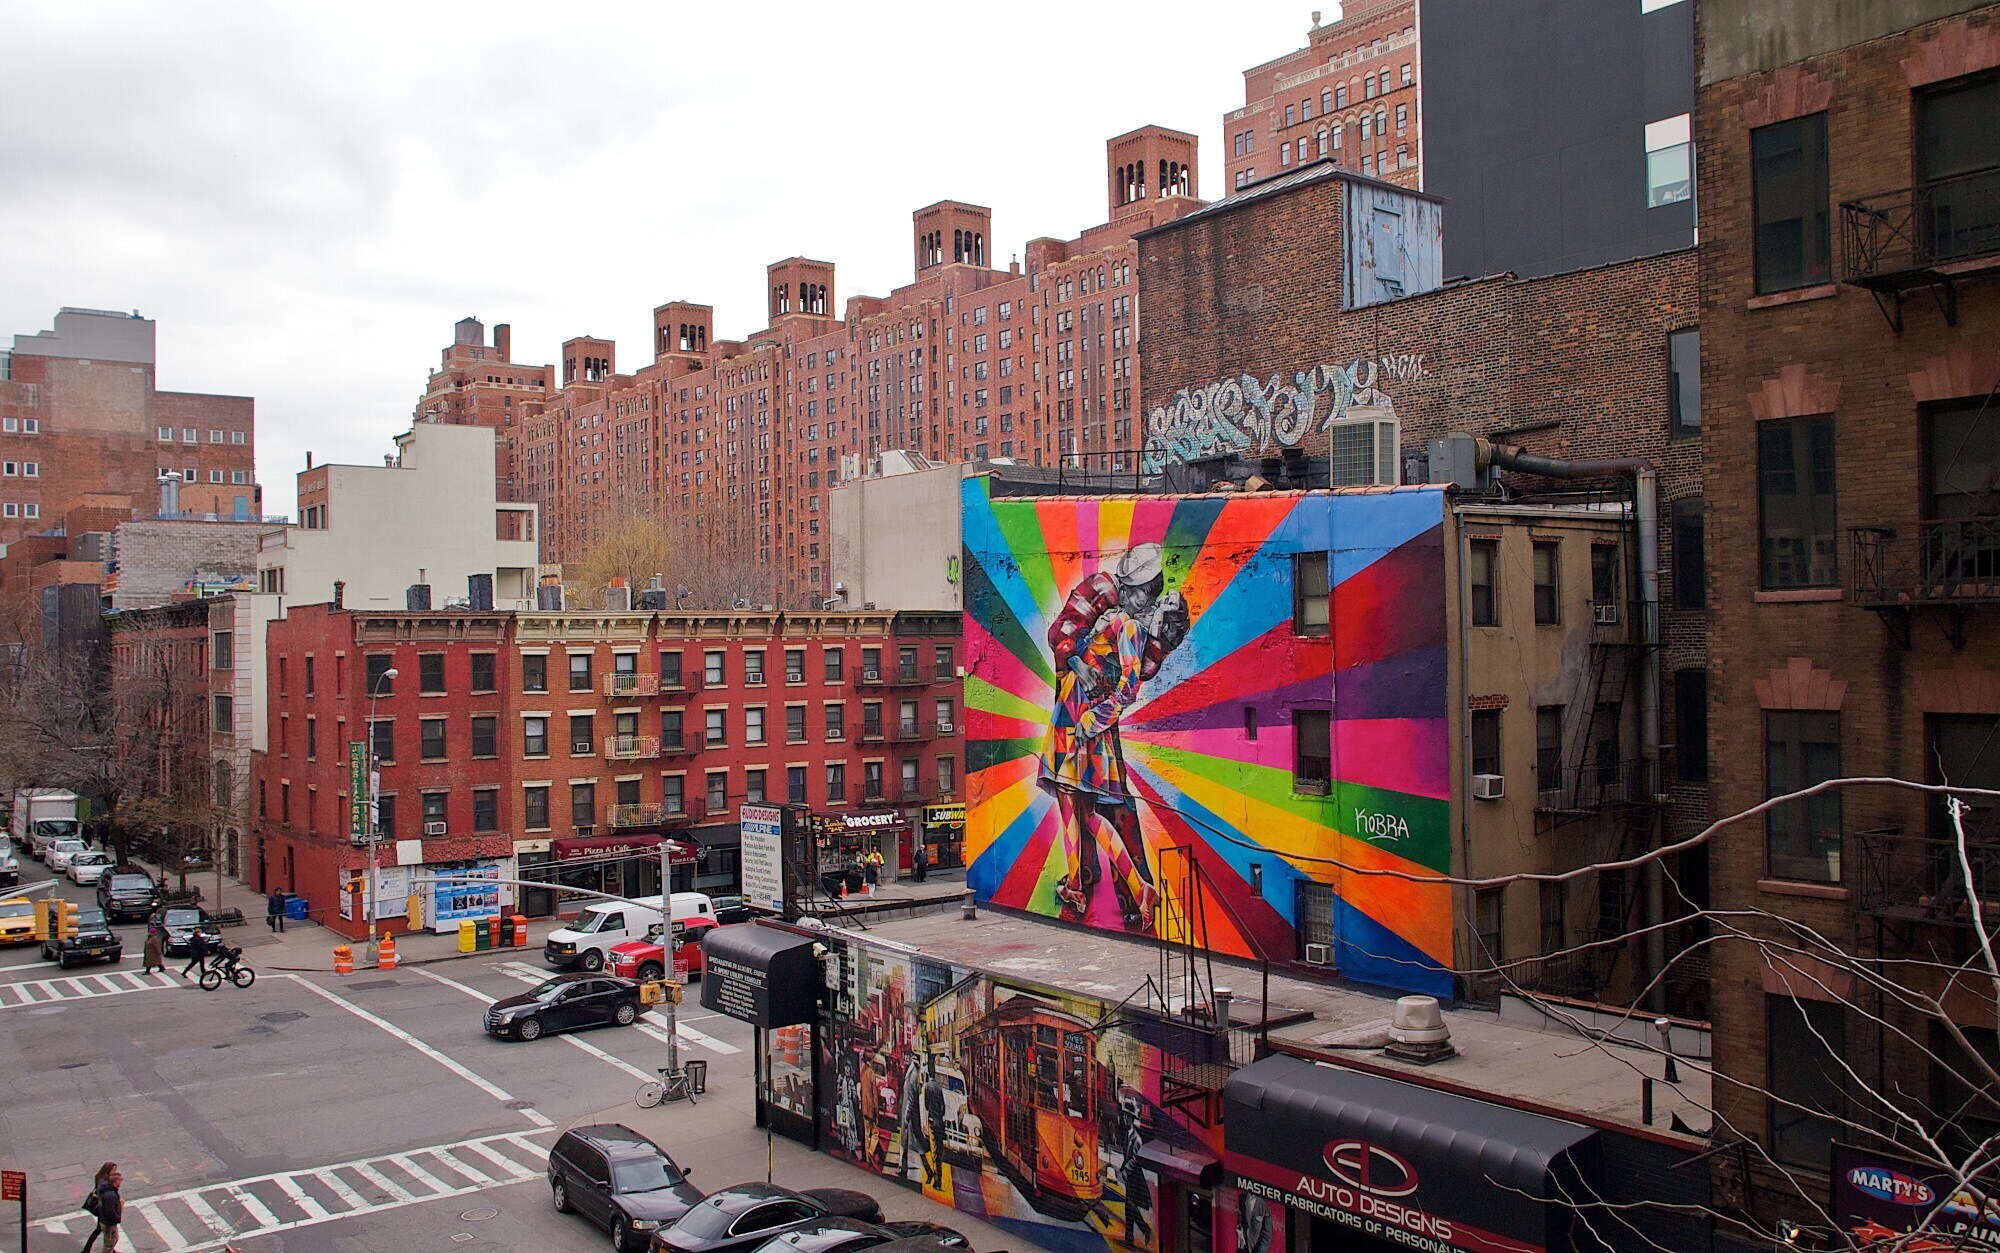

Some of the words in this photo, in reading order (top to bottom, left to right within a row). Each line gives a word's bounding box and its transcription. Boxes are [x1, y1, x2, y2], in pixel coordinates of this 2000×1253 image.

[846, 813, 894, 828] GROCERY
[932, 809, 966, 821] SUBWA
[1354, 807, 1410, 838] KOBRA
[584, 847, 603, 855] Pizza
[1072, 1169, 1089, 1182] 1945
[1852, 1170, 1929, 1202] MARTY'S
[1237, 1176, 1282, 1201] MASTER
[1284, 1193, 1362, 1229] FABRICATORS
[1365, 1219, 1382, 1234] OF
[1386, 1227, 1466, 1253] PERSONAL
[1296, 1176, 1354, 1208] AUTO
[1360, 1194, 1452, 1240] DESIGNS
